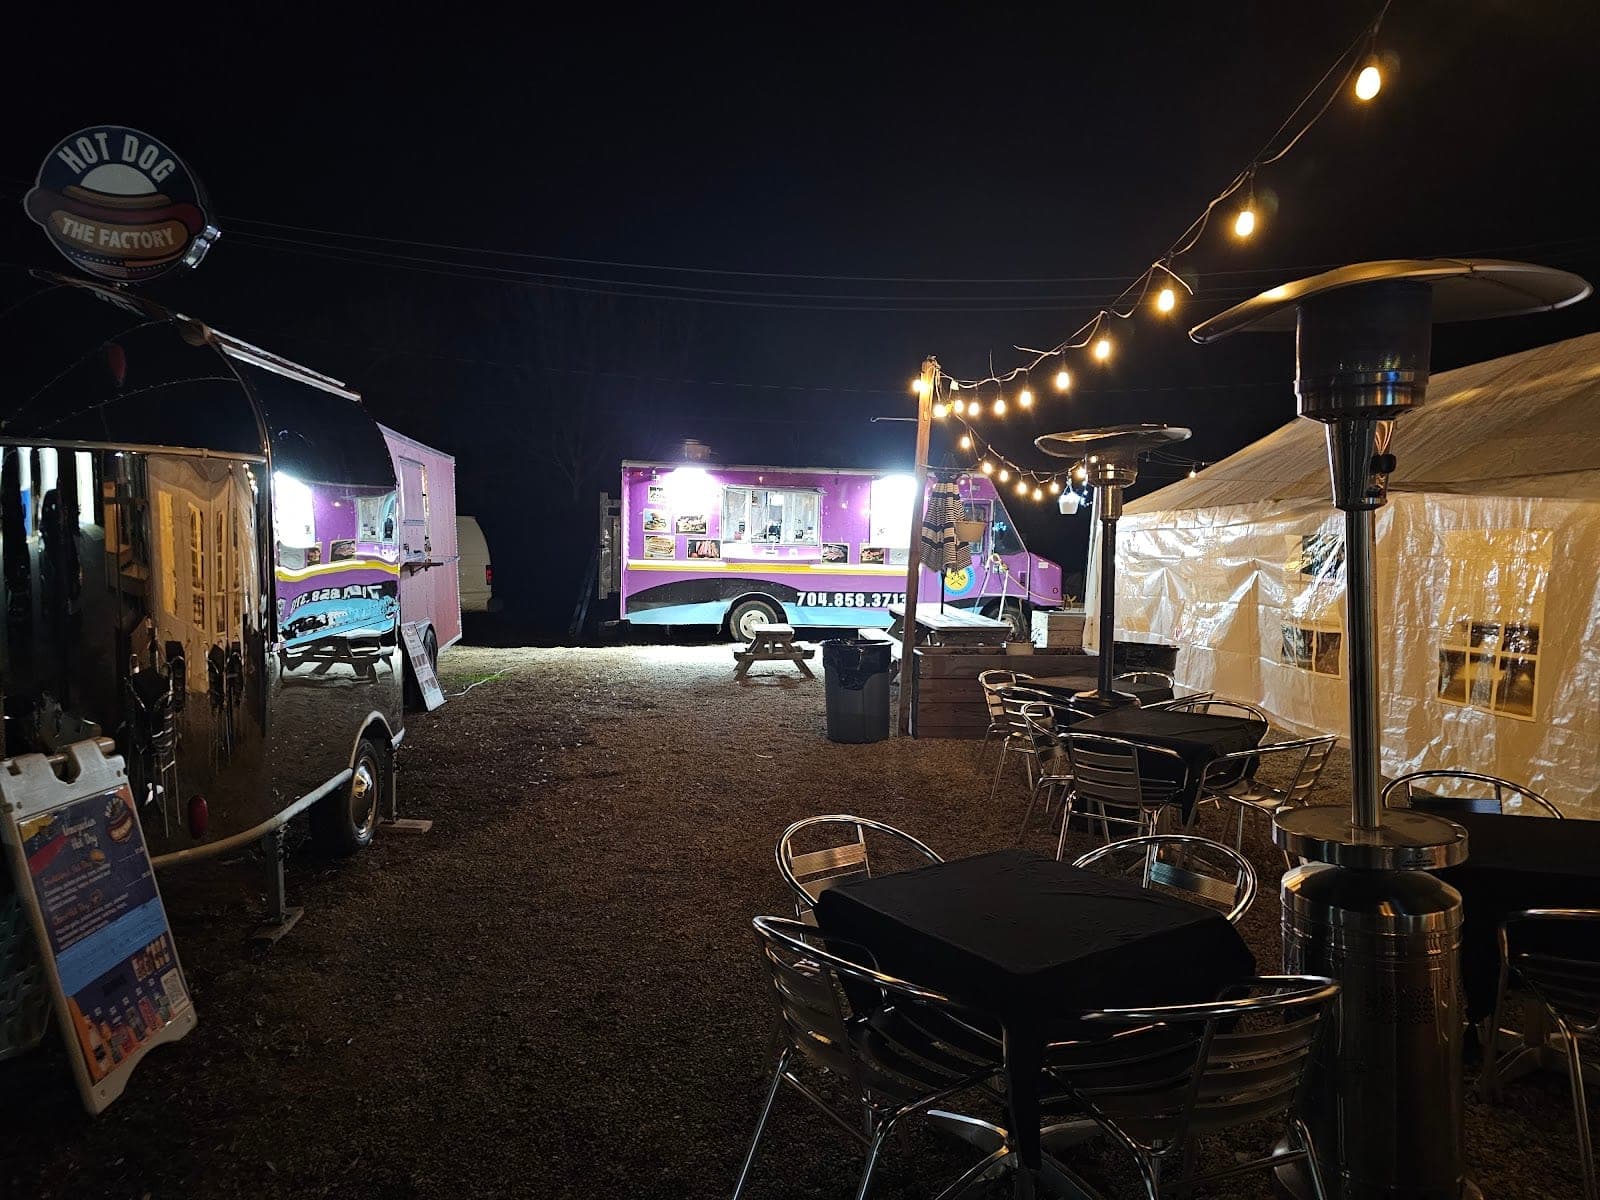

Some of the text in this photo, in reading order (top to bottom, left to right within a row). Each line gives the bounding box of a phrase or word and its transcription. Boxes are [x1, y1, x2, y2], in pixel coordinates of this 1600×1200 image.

[57, 132, 177, 183] HOT DOG
[61, 217, 175, 249] THE FACTORY
